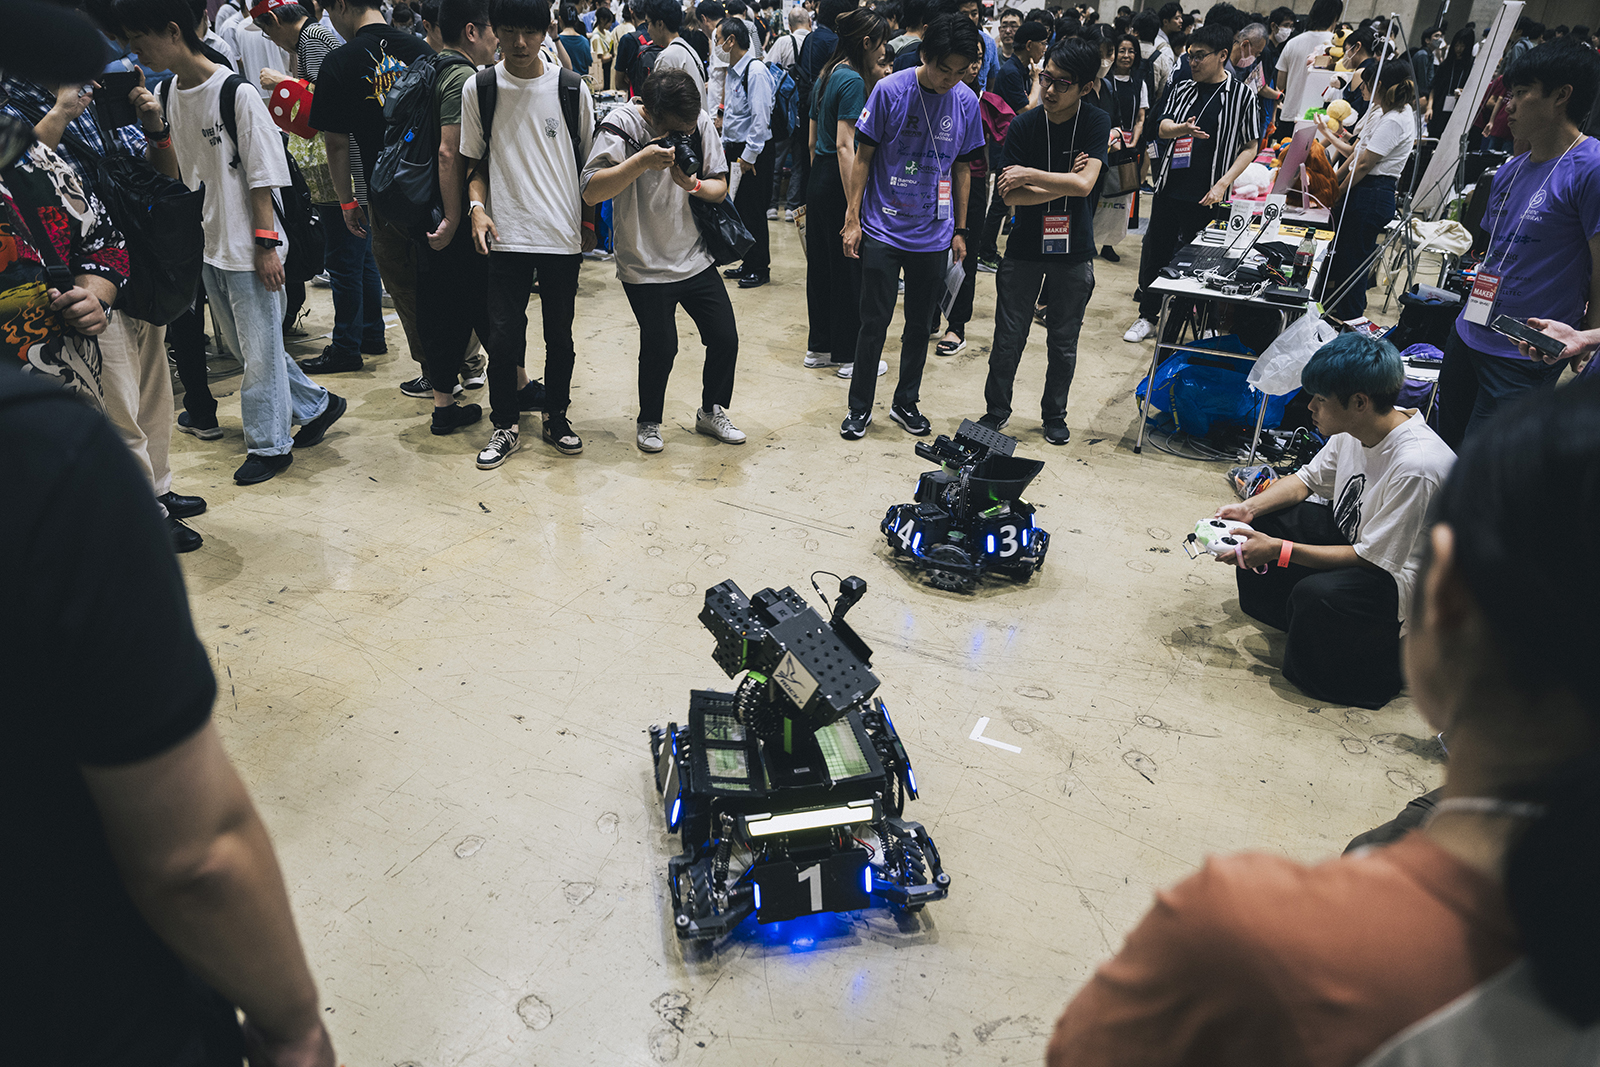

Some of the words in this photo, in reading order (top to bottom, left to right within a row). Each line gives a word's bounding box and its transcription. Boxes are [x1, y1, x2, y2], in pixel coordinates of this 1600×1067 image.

[1492, 249, 1519, 261] Sesia
[1473, 287, 1494, 299] MAKER
[897, 518, 915, 550] 4
[999, 524, 1019, 558] 3
[779, 679, 804, 705] ROCKY
[797, 863, 823, 912] 1
